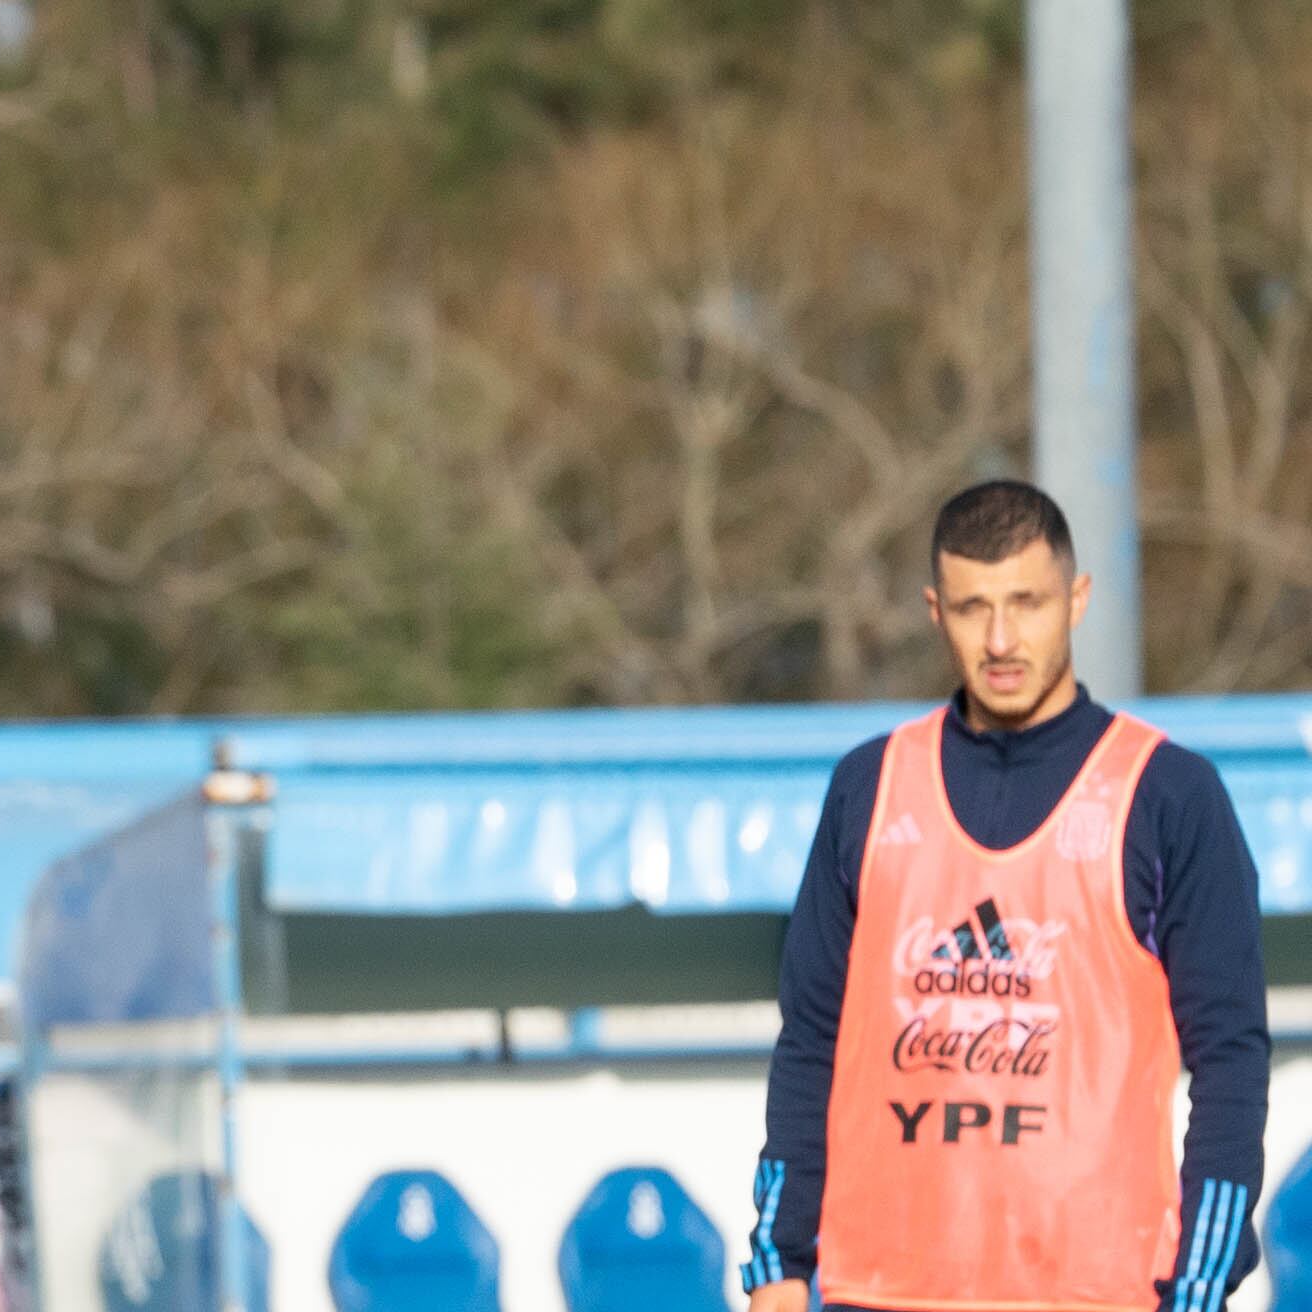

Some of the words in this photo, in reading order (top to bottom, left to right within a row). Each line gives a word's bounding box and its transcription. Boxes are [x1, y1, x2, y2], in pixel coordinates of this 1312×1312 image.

[915, 957, 1031, 997] adidas
[892, 1016, 1058, 1076] Coca-Cola
[888, 1101, 1048, 1146] YPF
